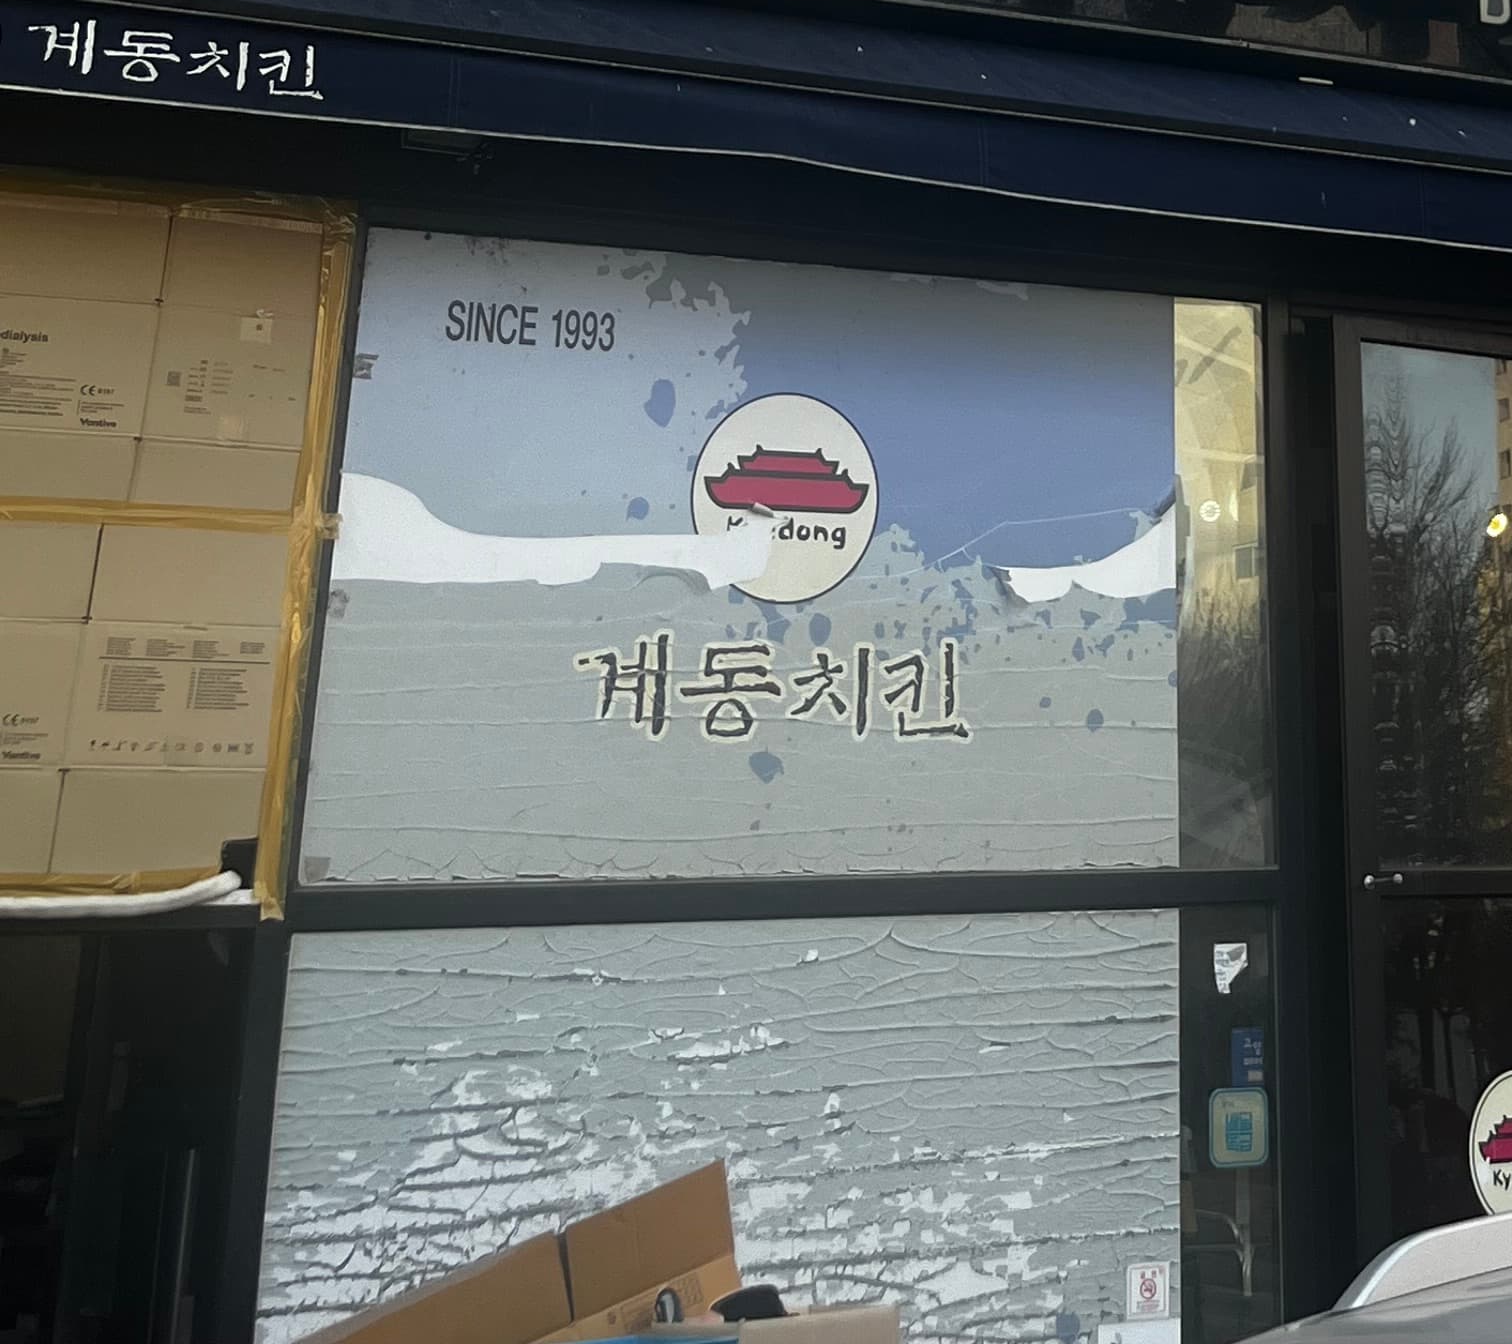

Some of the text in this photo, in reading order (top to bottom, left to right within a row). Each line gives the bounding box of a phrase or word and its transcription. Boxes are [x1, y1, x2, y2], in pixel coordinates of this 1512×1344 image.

[28, 19, 324, 101] 계동치킨
[445, 299, 617, 353] SINCE 1993
[726, 515, 847, 550] Kdong
[574, 631, 973, 744] 계동치킨
